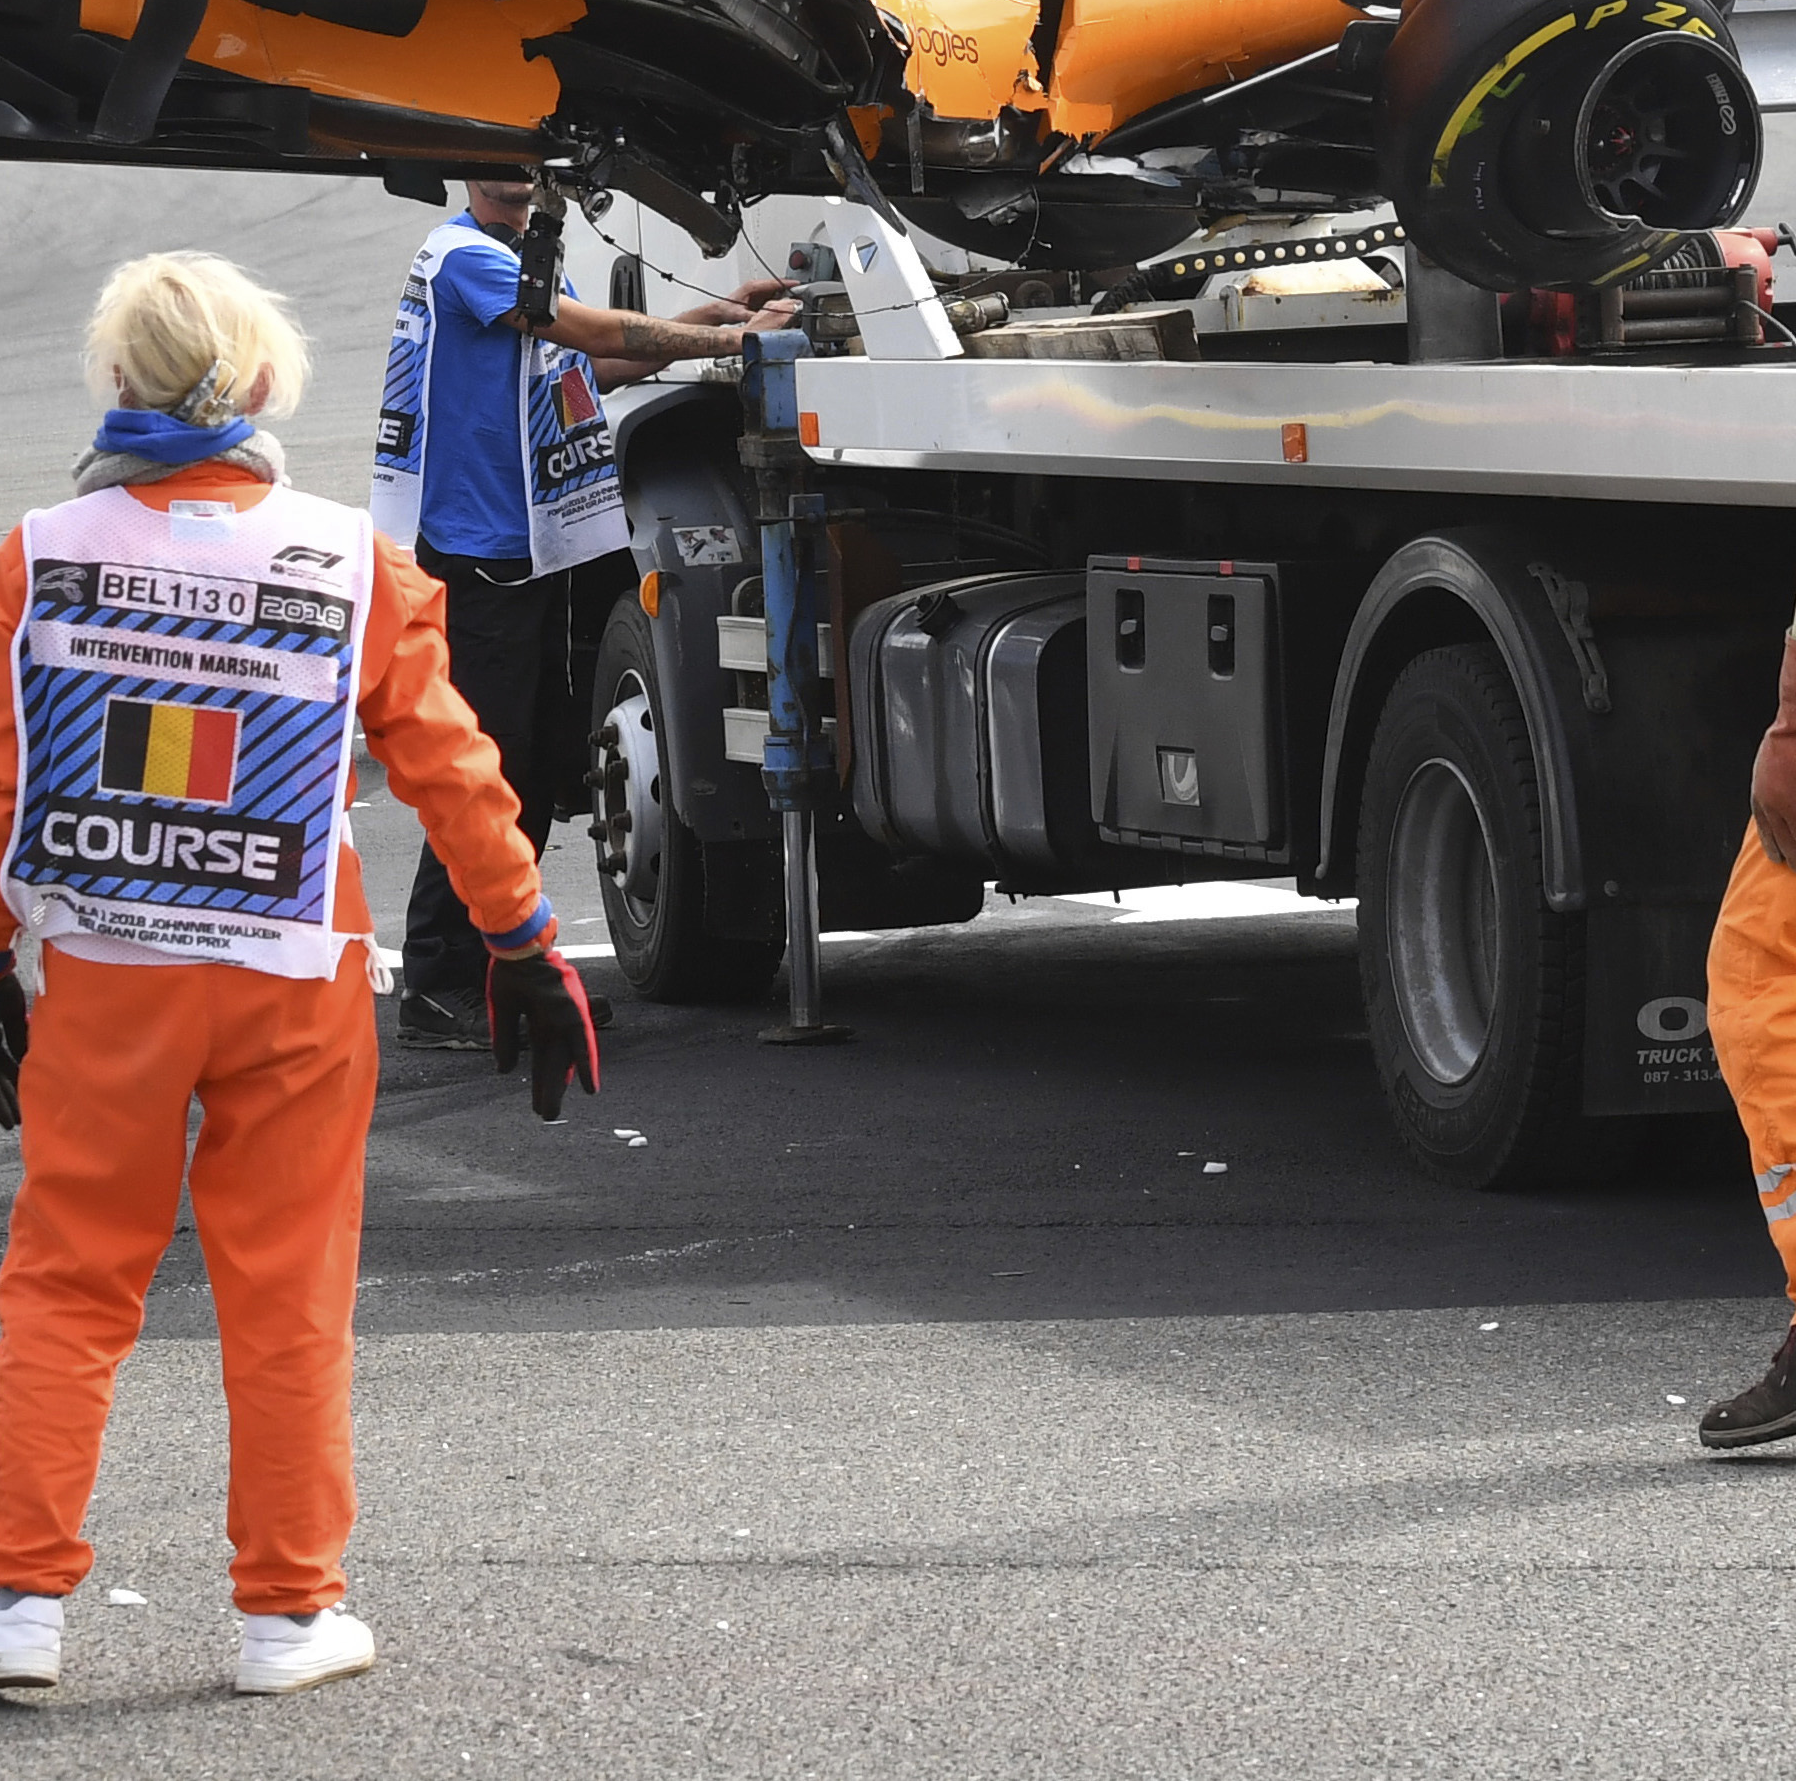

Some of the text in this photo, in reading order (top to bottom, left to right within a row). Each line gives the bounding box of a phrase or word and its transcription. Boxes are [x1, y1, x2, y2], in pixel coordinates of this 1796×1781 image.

[1641, 1, 1717, 39] ZE
[259, 594, 347, 632] 2018
[69, 636, 282, 682] INTERVENTION MARSHAL
[41, 809, 282, 882] COURSE
[77, 916, 232, 950] BELGIAN GRAND PRIX
[109, 912, 147, 928] 2018
[149, 916, 216, 935] JOHNNIE
[218, 923, 282, 941] WALKER
[1636, 1047, 1703, 1066] TRUCK
[1643, 1070, 1670, 1084] 087
